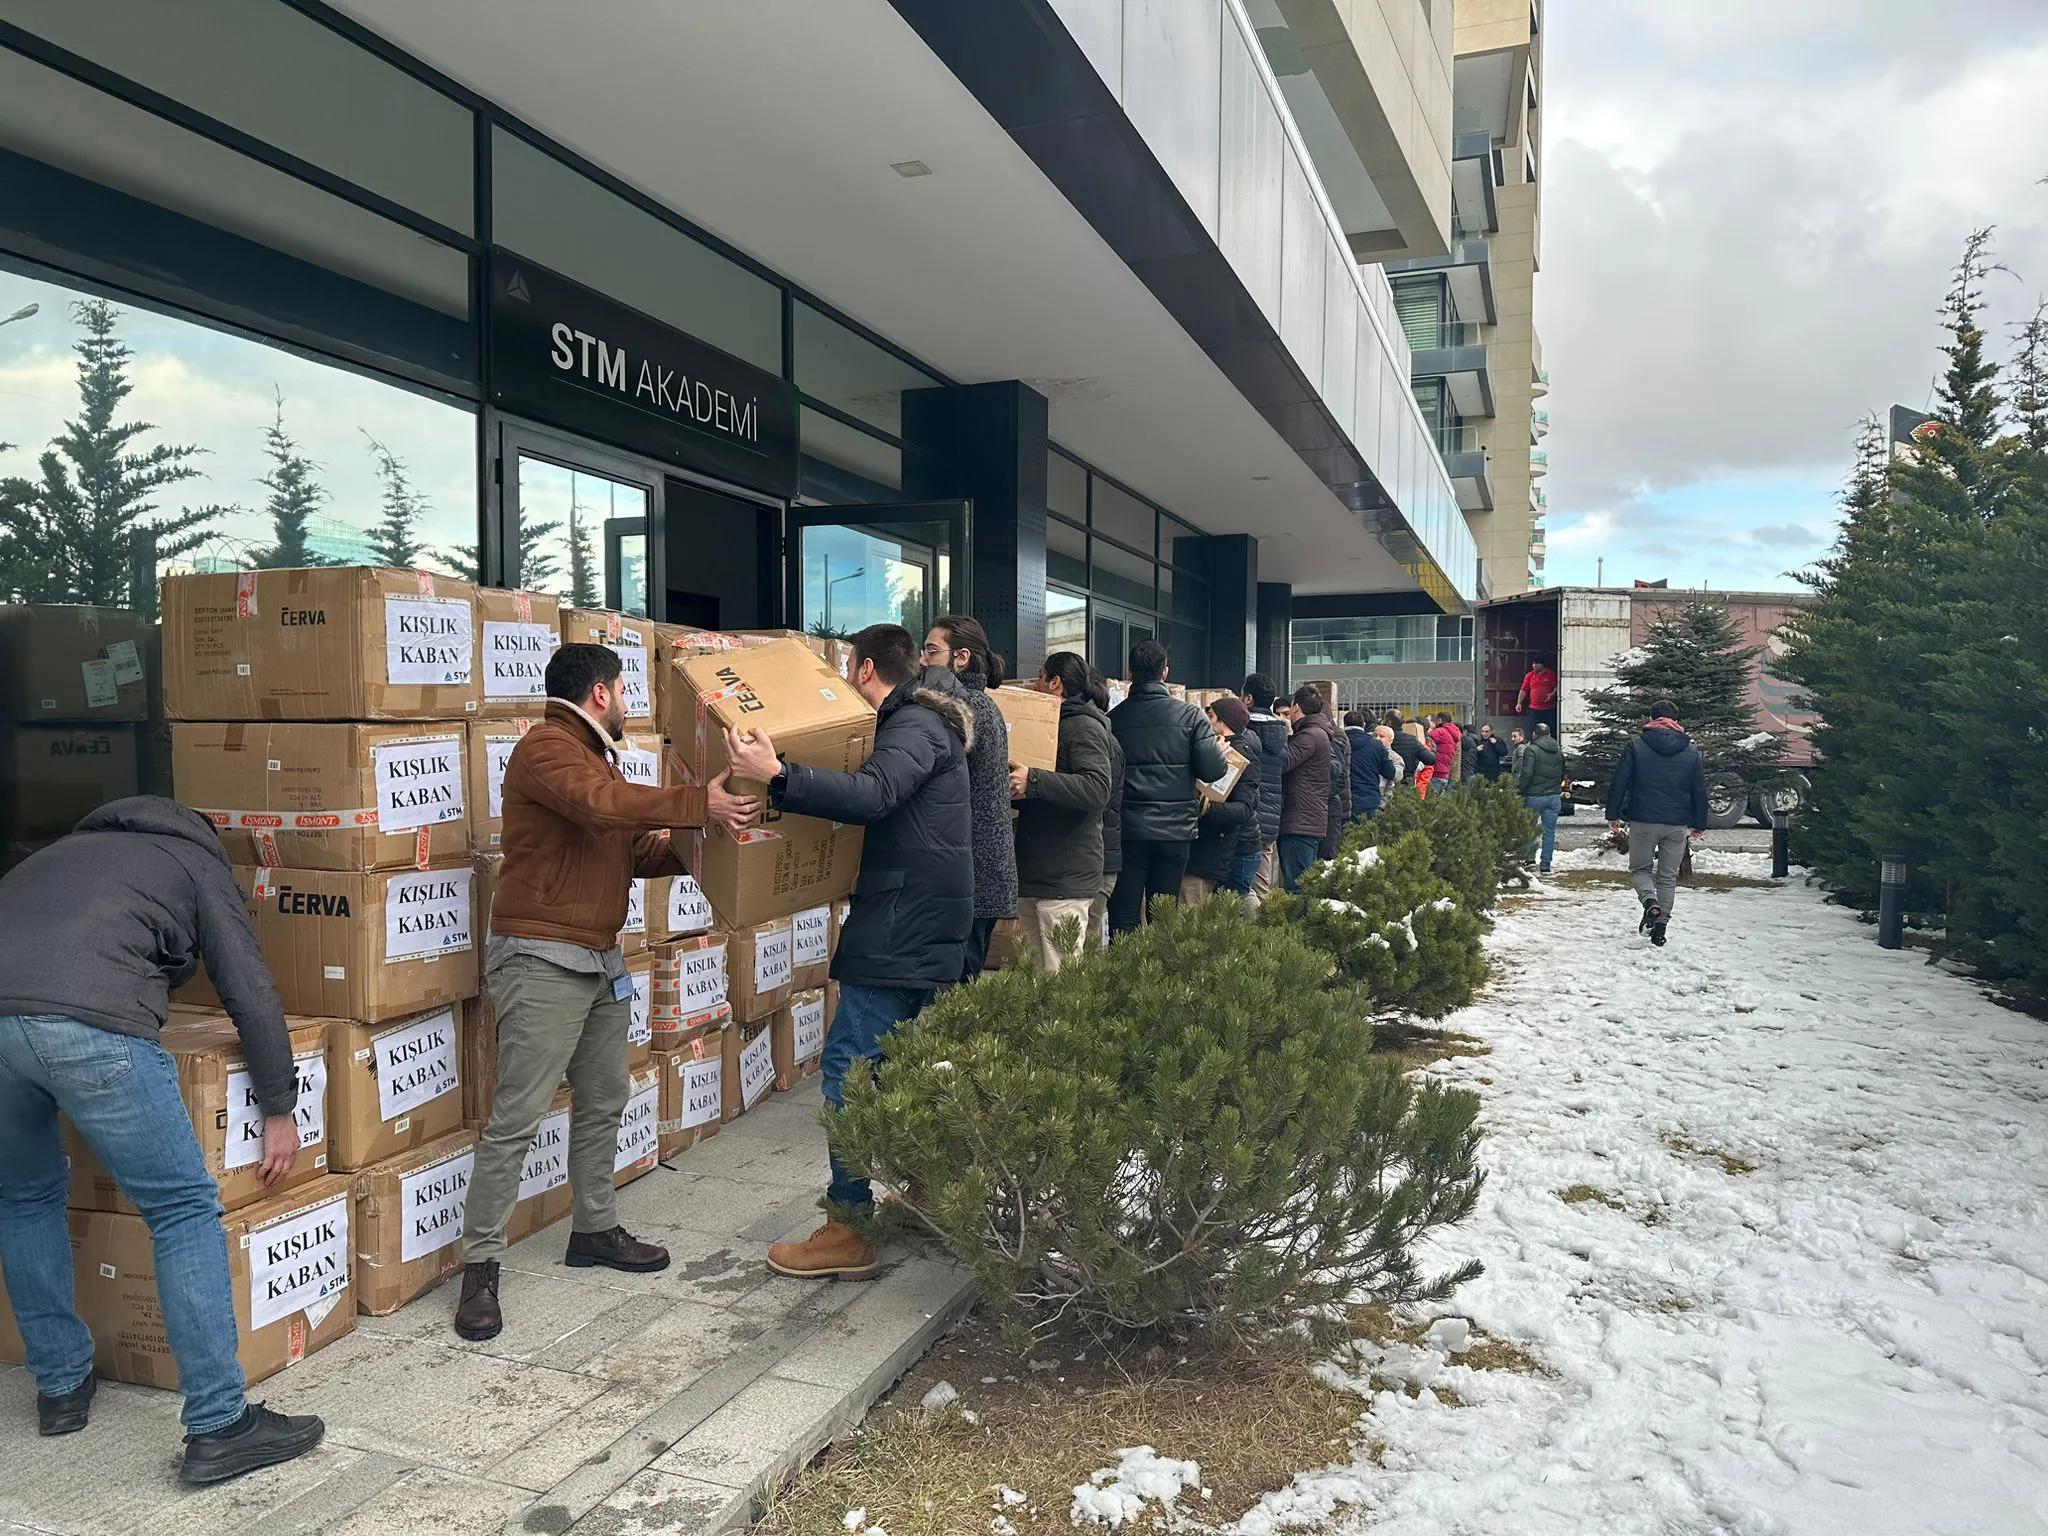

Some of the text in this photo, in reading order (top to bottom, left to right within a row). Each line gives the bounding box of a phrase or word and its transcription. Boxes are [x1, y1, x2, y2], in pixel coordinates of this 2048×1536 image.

[551, 322, 758, 442] STM AKADEMİ
[399, 615, 458, 637] KIŞLIK
[494, 634, 542, 655] KIŞLIK
[400, 646, 459, 664] KABAN
[494, 661, 543, 678] KABAN
[637, 701, 649, 709] STM
[388, 755, 450, 780] KIŞLIK
[390, 784, 452, 809] KABAN
[447, 806, 462, 817] STM
[398, 881, 458, 905] KIŞLIK
[398, 909, 458, 934] KABAN
[632, 917, 643, 925] STM
[796, 915, 824, 932] KIŞLIK
[452, 932, 468, 942] STM
[796, 936, 824, 950] KABAN
[763, 944, 788, 959] KIŞLIK
[686, 955, 717, 976] KIŞLIK
[762, 961, 788, 979] KABAN
[686, 977, 718, 997] KABAN
[798, 1012, 822, 1029] KIŞLIK
[635, 1029, 646, 1037] STM
[798, 1029, 822, 1047] KABAN
[388, 1029, 446, 1067] KIŞLIK
[744, 1040, 767, 1069] KIŞLIK
[391, 1056, 447, 1096] KABAN
[442, 1076, 457, 1089] STM
[690, 1070, 719, 1089] KIŞLIK
[745, 1058, 768, 1088] KABAN
[689, 1091, 718, 1112] KABAN
[303, 1129, 320, 1143] STM
[647, 1139, 657, 1150] STM
[520, 1154, 561, 1182] ABAN
[554, 1172, 567, 1184] STM
[415, 1170, 468, 1206] KIŞLIK
[267, 1220, 337, 1267] KIŞLIK
[267, 1252, 337, 1301] KABAN
[329, 1273, 346, 1290] STM
